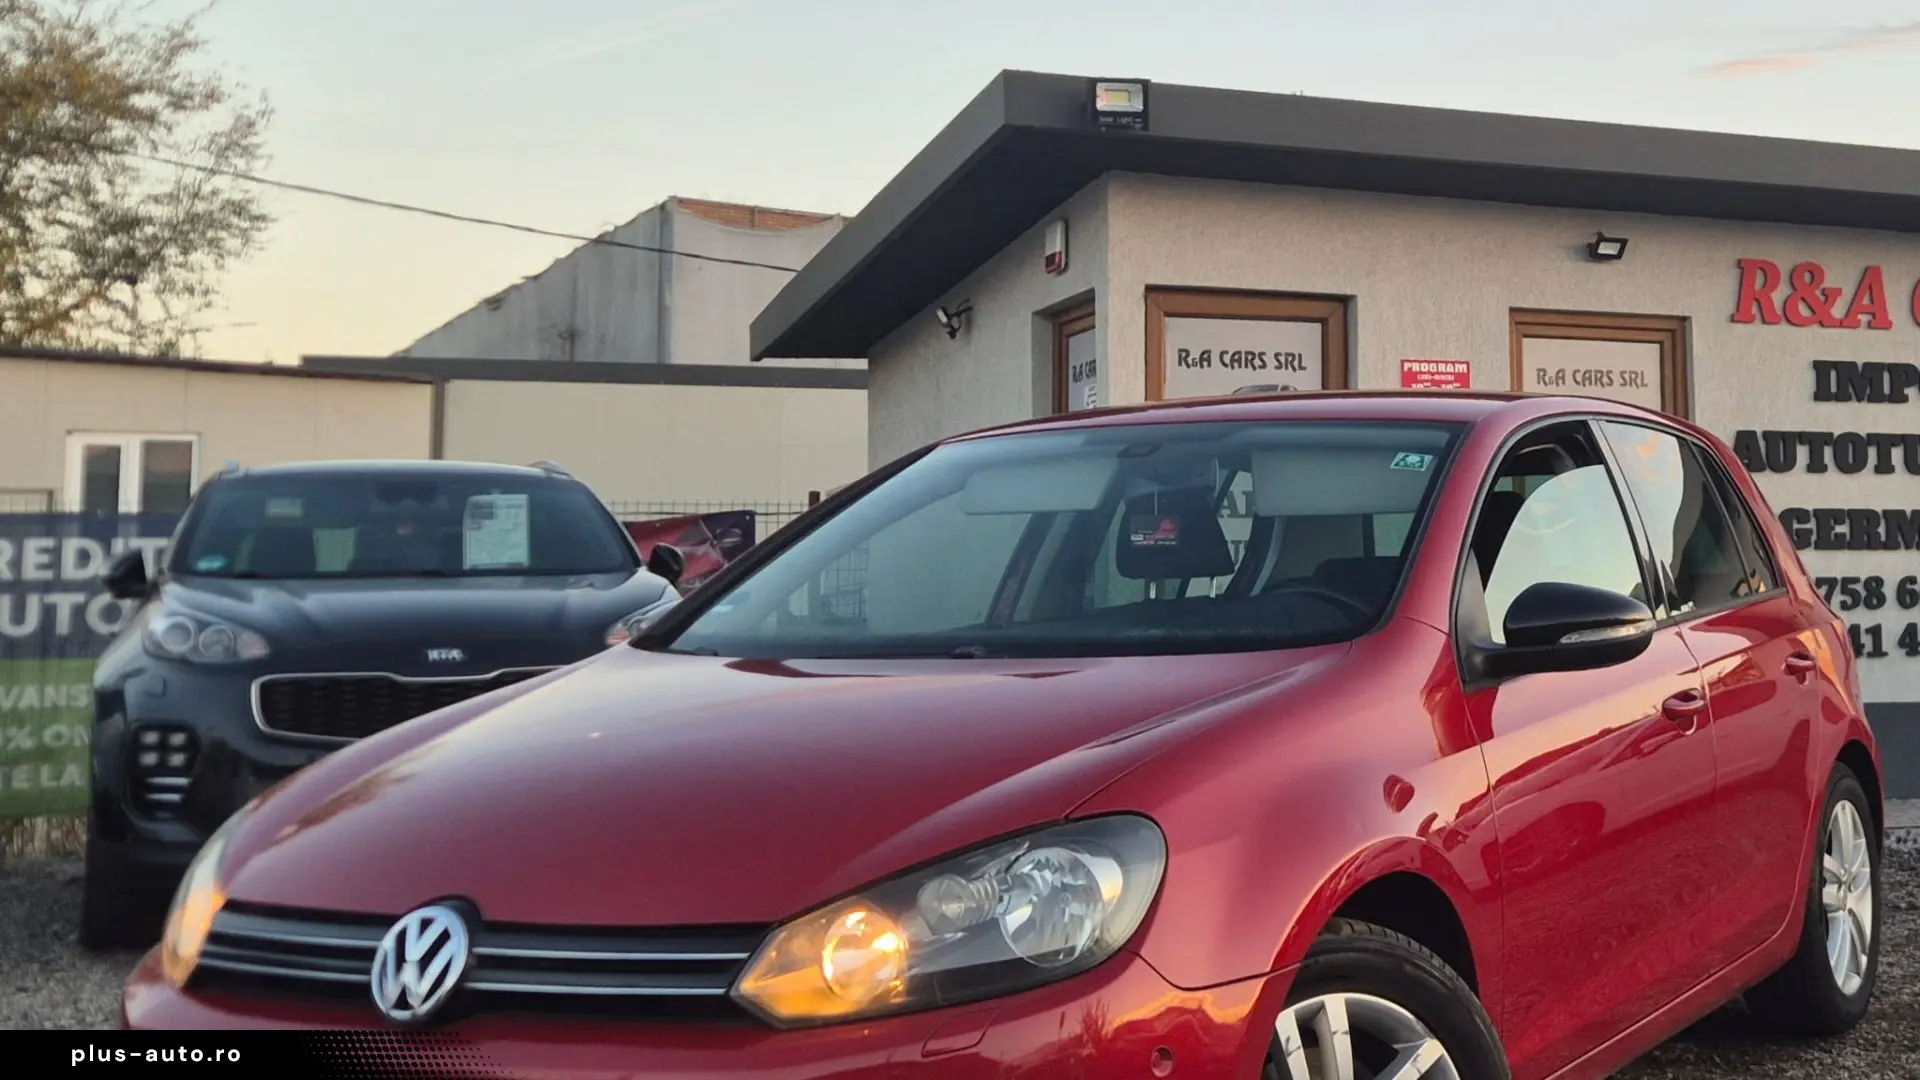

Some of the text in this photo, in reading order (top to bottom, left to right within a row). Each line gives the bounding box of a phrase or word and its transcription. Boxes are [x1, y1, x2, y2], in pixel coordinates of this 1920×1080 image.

[1731, 258, 1894, 330] R&A
[1177, 348, 1307, 372] R&A CARS SRL
[1403, 362, 1468, 373] PROGRAM
[1572, 369, 1614, 388] CARS
[1619, 370, 1648, 389] SRL
[1812, 360, 1920, 403] IMP
